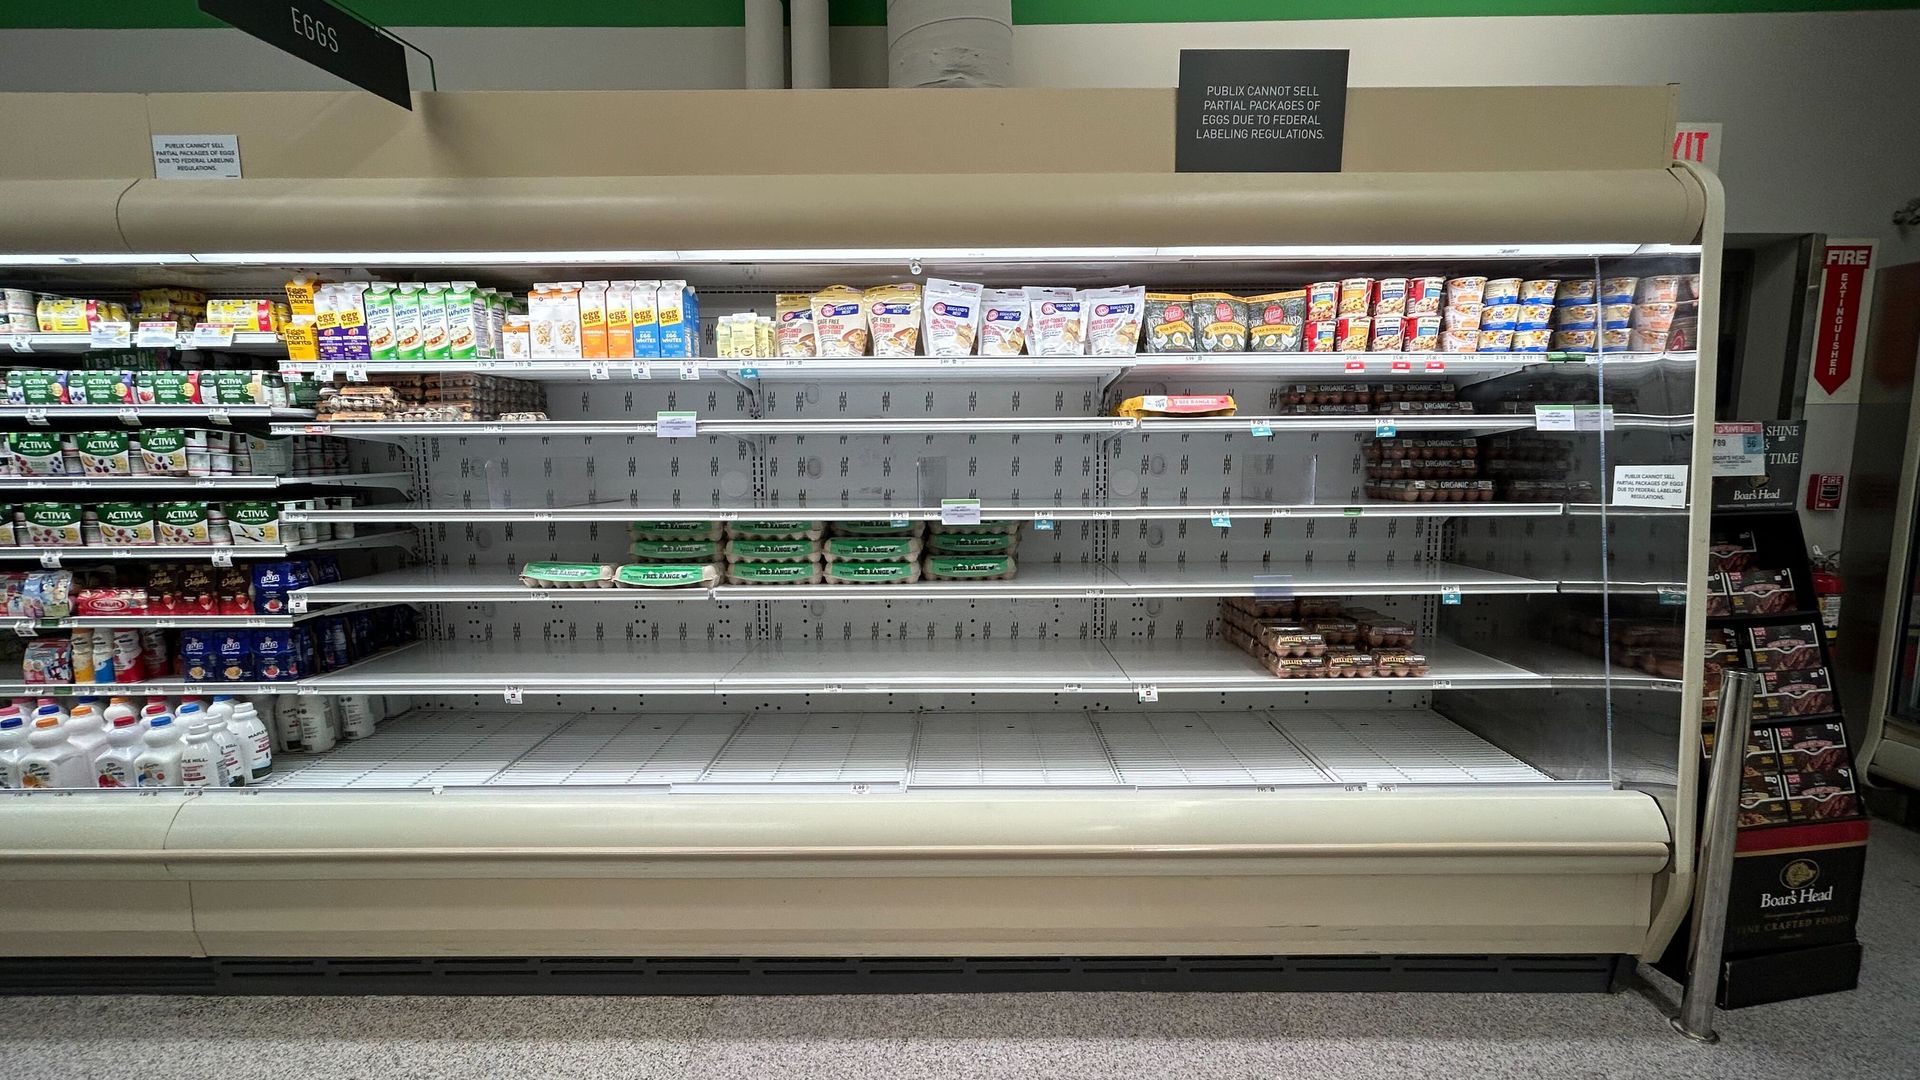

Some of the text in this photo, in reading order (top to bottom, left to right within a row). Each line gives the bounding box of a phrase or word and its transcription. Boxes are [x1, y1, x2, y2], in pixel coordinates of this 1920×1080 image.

[291, 6, 339, 53] EGGS
[1206, 86, 1319, 96] PUBLIX CANNOT SELL
[1204, 100, 1321, 111] PARTIAL PACKAGES OF
[1202, 114, 1321, 125] EGGS DUE TO FEDERAL
[1196, 129, 1325, 139] LABELING REGULATIONS.
[1826, 250, 1869, 265] FIRE
[341, 312, 358, 322] egg
[368, 308, 389, 317] Whites
[396, 308, 417, 317] Whites
[422, 308, 443, 317] Whites
[449, 308, 470, 317] Whites
[582, 310, 599, 320] egg
[609, 310, 626, 320] egg
[634, 310, 651, 320] egg
[660, 310, 677, 320] egg
[318, 313, 335, 323] egg
[1828, 273, 1848, 376] EXTINGUISHER
[1766, 426, 1799, 436] SHINE
[19, 441, 52, 449] ACTIVIA
[87, 441, 119, 449] ACTIVIA
[147, 438, 177, 446] ACTIVIA
[1769, 453, 1799, 465] TIME
[1822, 475, 1842, 484] FIRE
[1733, 488, 1780, 500] Boar's Head
[34, 511, 71, 520] ACTIVIA
[107, 511, 143, 519] ACTIVIA
[166, 510, 198, 519] ACTIVIA
[237, 510, 269, 518] ACTIVIA
[1760, 886, 1833, 908] Boar's Head
[1764, 918, 1812, 932] CRAFTED
